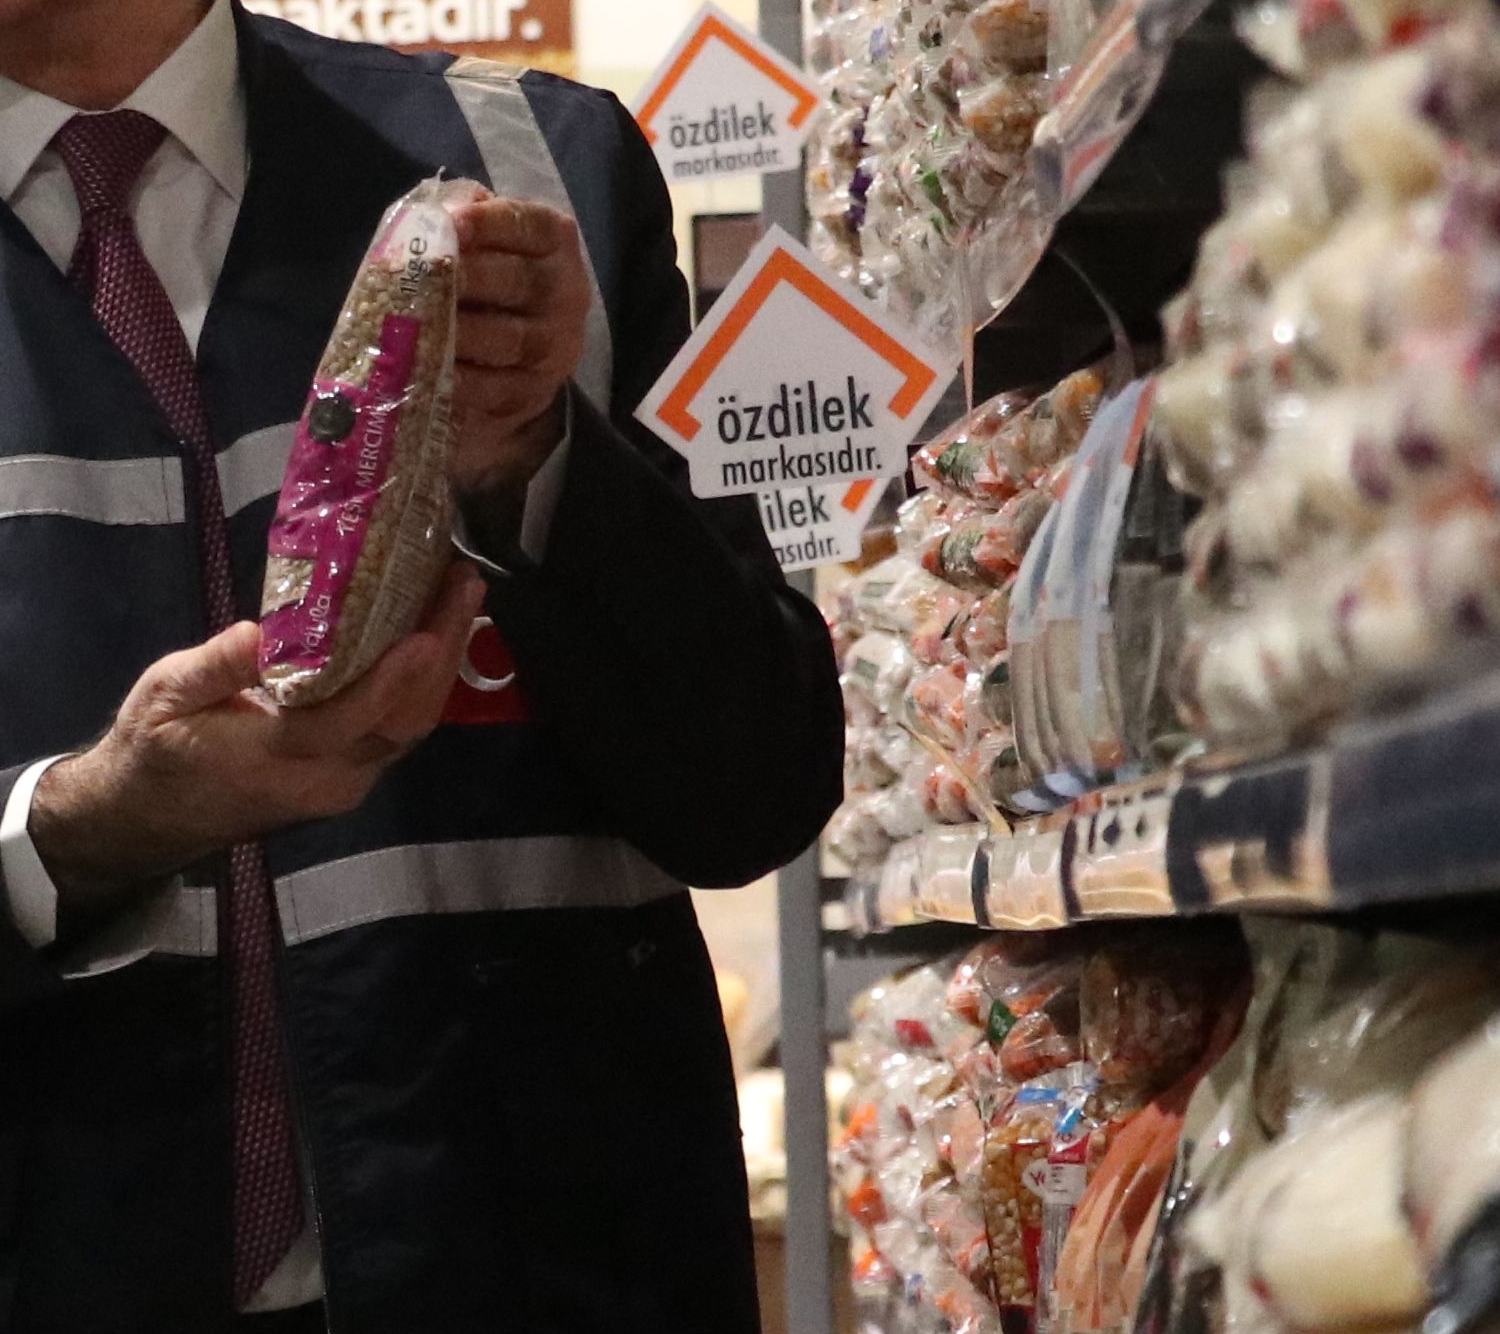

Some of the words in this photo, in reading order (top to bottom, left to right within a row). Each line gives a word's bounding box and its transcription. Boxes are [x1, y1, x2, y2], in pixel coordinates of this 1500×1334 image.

[669, 100, 777, 149] özdilek
[672, 142, 785, 178] markasıdır.
[717, 375, 874, 445] özdilek
[721, 437, 883, 488] markasıdır.
[762, 485, 831, 533] ilek
[773, 530, 842, 565] asıdır.
[300, 593, 334, 658] Yayla
